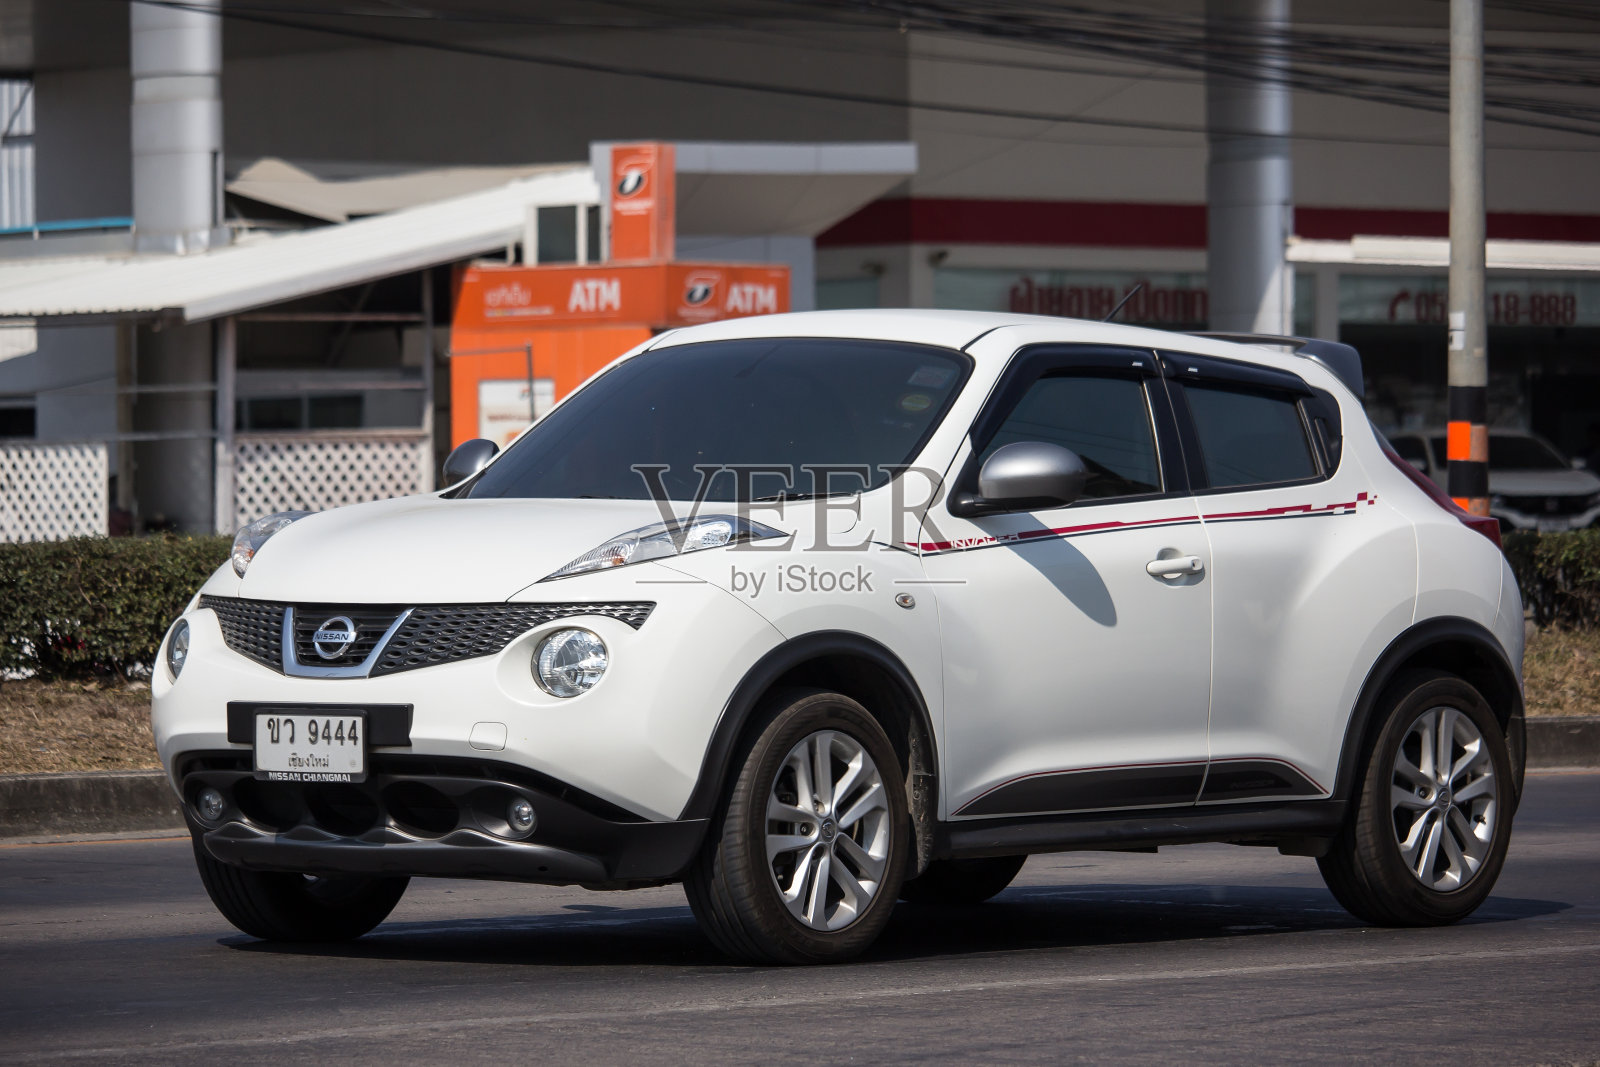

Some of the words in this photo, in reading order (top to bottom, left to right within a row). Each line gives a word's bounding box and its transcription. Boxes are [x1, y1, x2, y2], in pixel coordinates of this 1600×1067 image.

[568, 278, 621, 312] ATM
[726, 283, 777, 313] ATM
[314, 632, 349, 641] NISSAN
[308, 719, 359, 745] 9444
[288, 752, 330, 768] เชียงใหม่
[268, 772, 301, 782] NISSAN
[302, 773, 351, 782] CHIANGMAI
